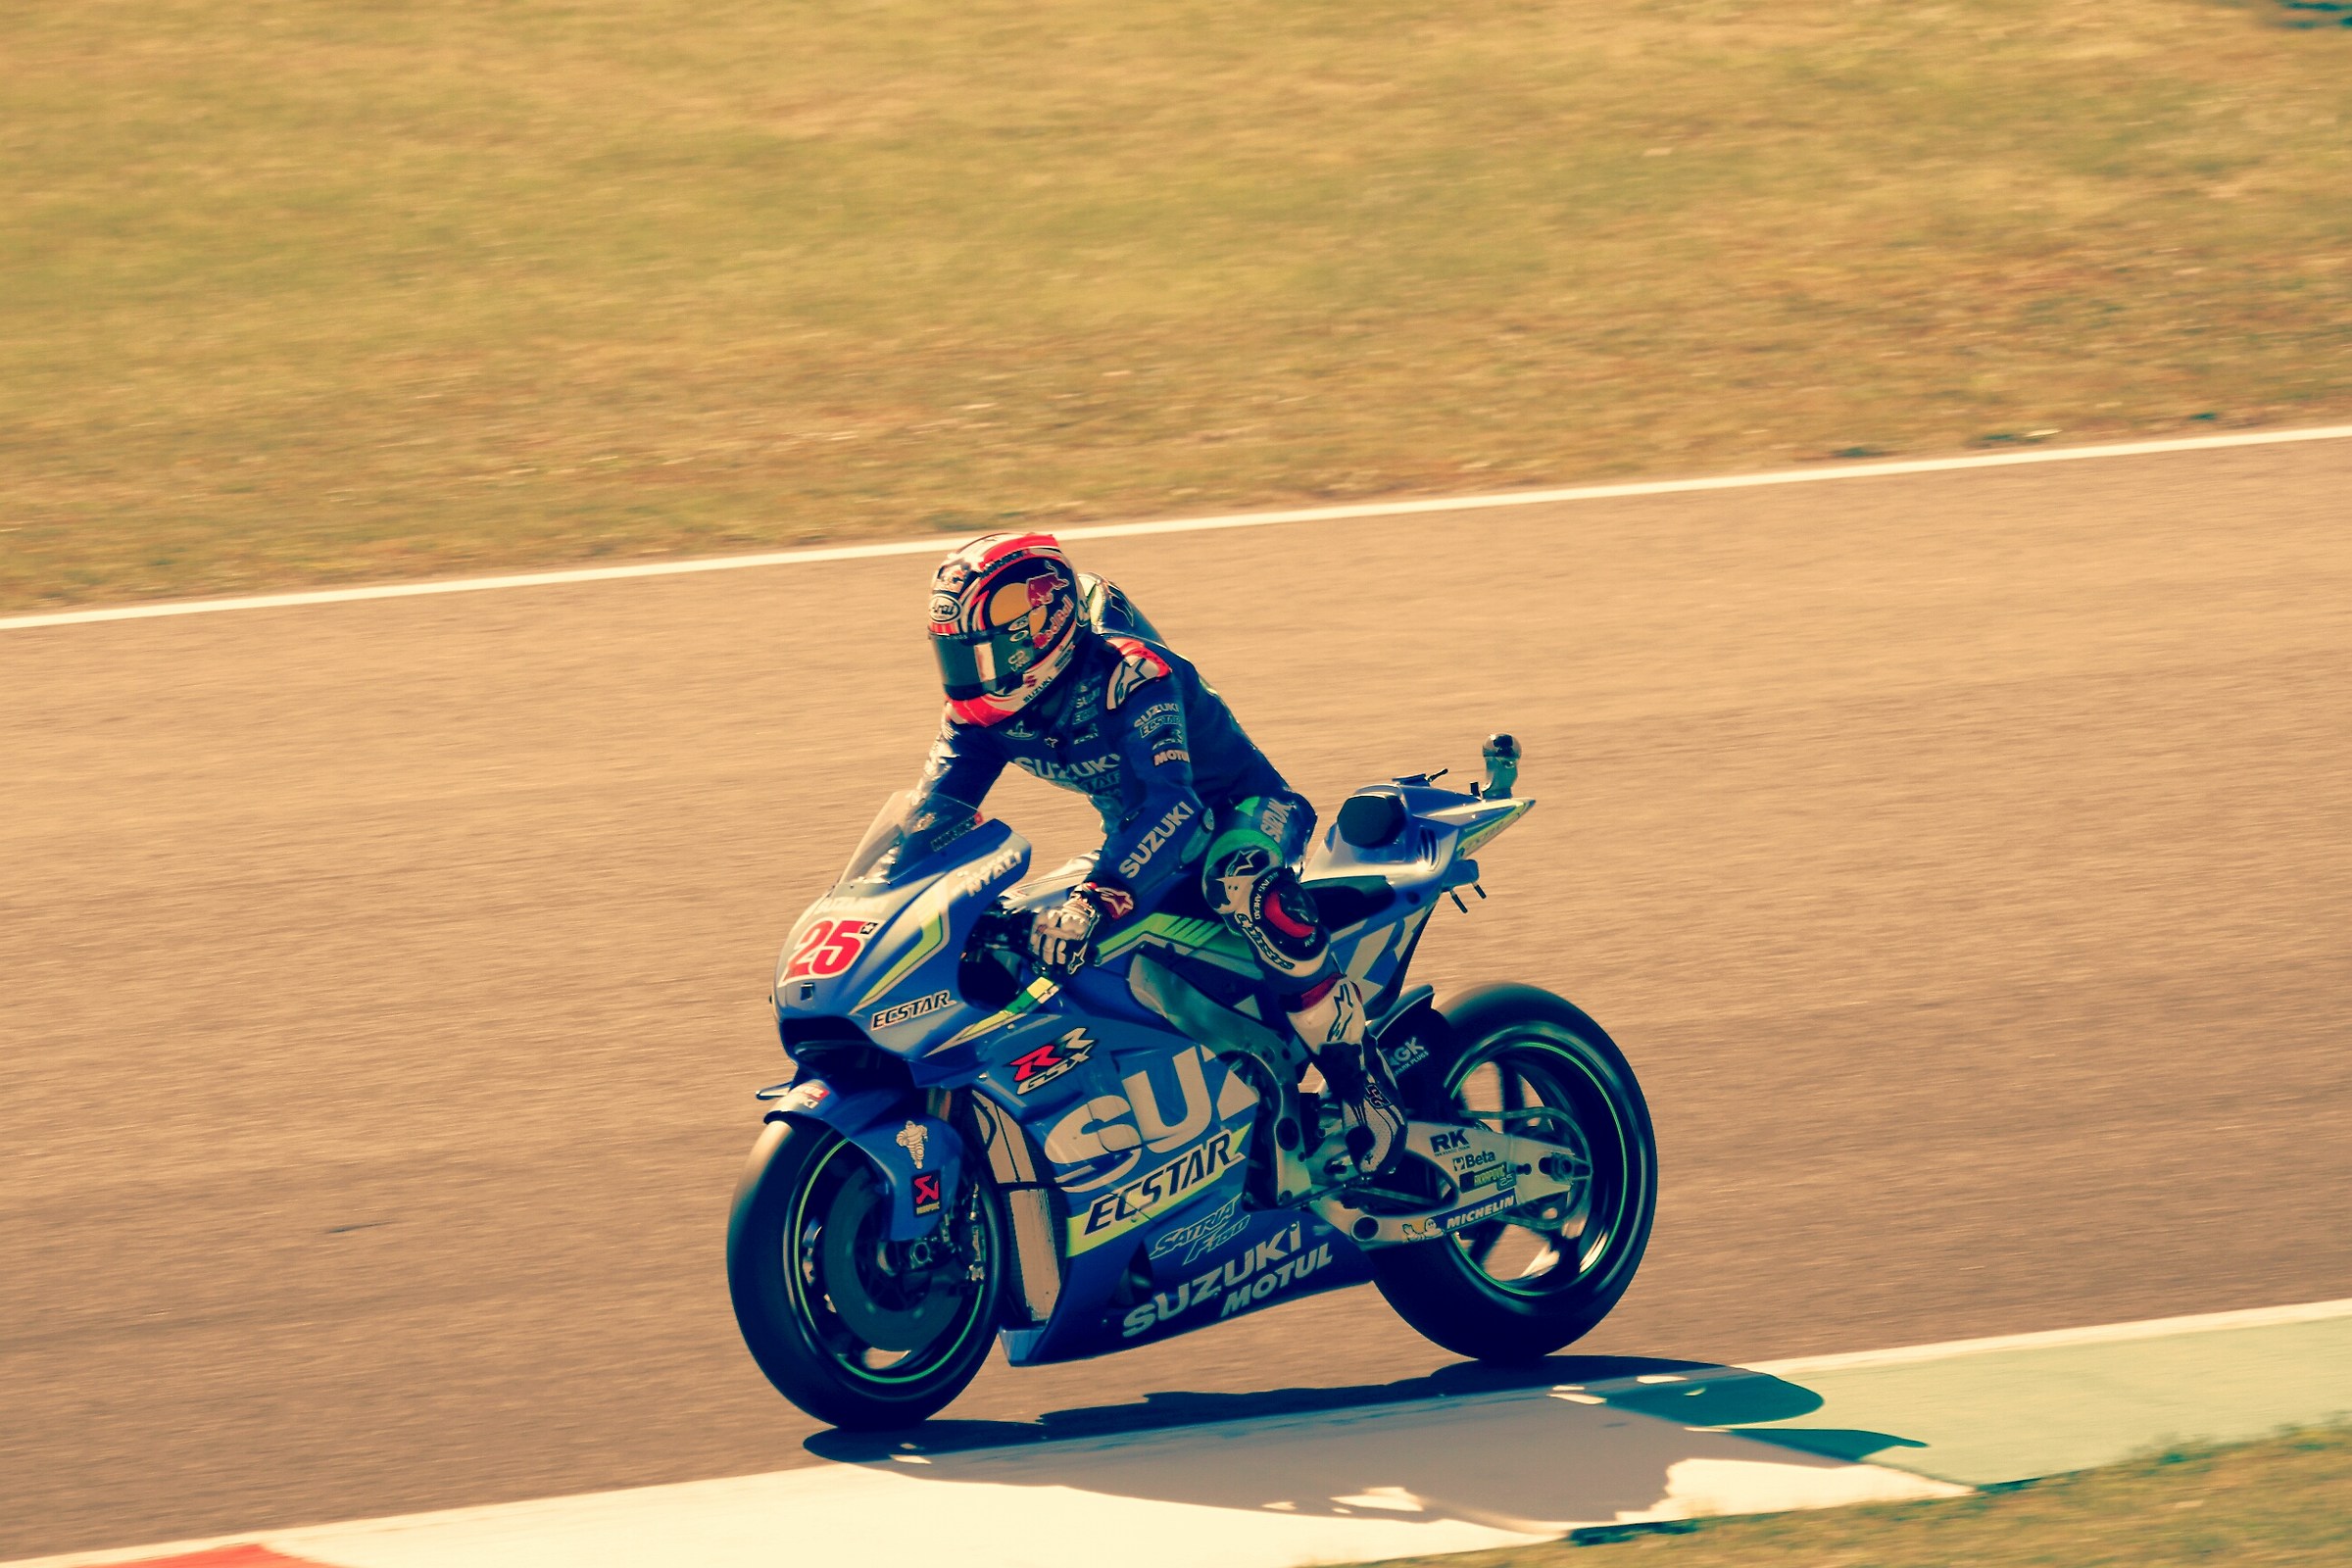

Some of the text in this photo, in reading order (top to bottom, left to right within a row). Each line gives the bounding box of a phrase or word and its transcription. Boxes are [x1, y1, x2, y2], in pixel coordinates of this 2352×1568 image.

[1023, 676, 1053, 703] SUZUKI
[1153, 750, 1191, 766] MOTU
[1118, 801, 1195, 879] SUZUKI
[780, 918, 867, 984] 25
[871, 991, 954, 1030] ECSTAR
[1430, 1129, 1470, 1153] RK
[1465, 1151, 1496, 1168] Beta
[1083, 1131, 1239, 1236] ECSTAR
[1446, 1195, 1515, 1230] MICHELIN
[1122, 1221, 1301, 1337] SUZUKI
[1221, 1243, 1333, 1317] MOTUL
